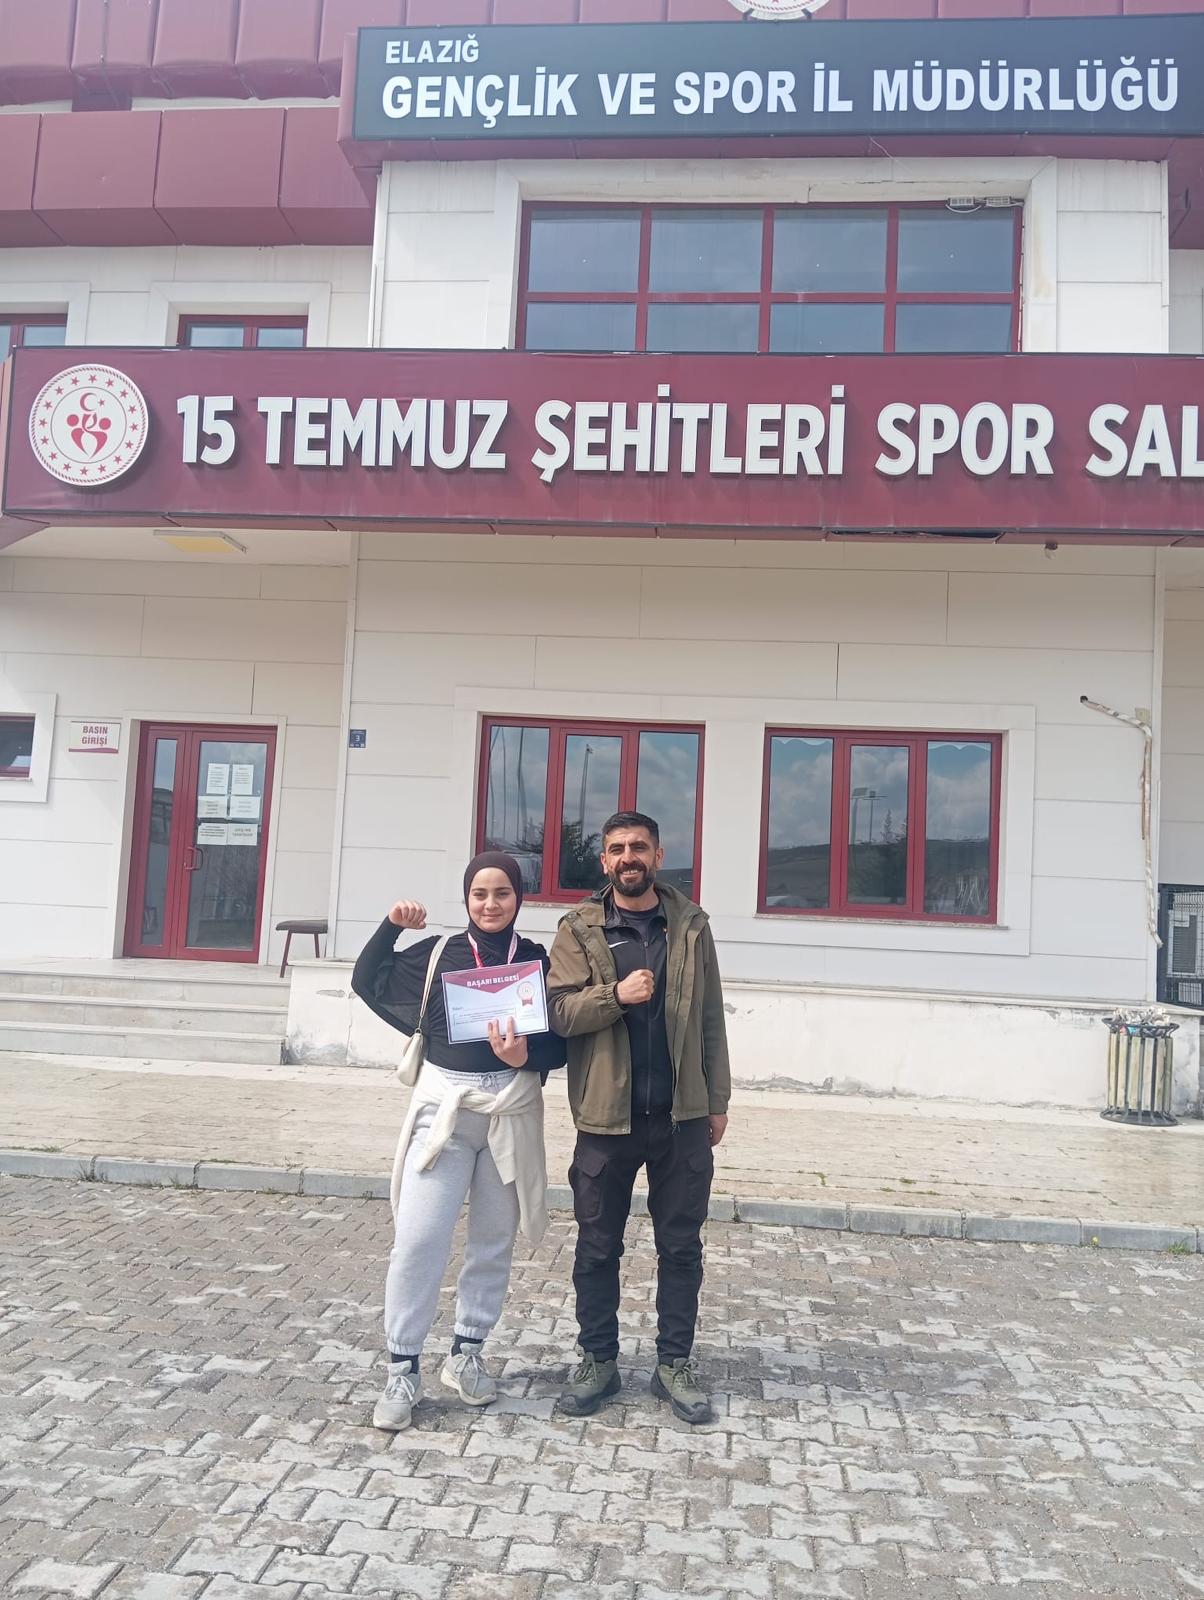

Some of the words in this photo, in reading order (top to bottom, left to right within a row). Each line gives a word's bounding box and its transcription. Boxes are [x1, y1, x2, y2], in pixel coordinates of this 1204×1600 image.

[385, 33, 479, 64] ELAZIĞ
[382, 66, 579, 128] GENÇLİK
[597, 72, 656, 115] VE
[673, 70, 797, 115] SPOR
[813, 62, 853, 112] İL
[872, 56, 1178, 112] MÜDÜRLÜĞÜ
[177, 395, 235, 465] 15
[257, 396, 508, 469] TEMMUZ
[531, 384, 845, 484] ŞEHİTLERİ
[874, 401, 1054, 477] SPOR
[1085, 402, 1204, 478] SAL
[81, 734, 108, 747] GİRİŞİ
[82, 725, 109, 735] BASIN
[466, 978, 492, 987] BAŞARI
[492, 973, 520, 983] BELGESİ
